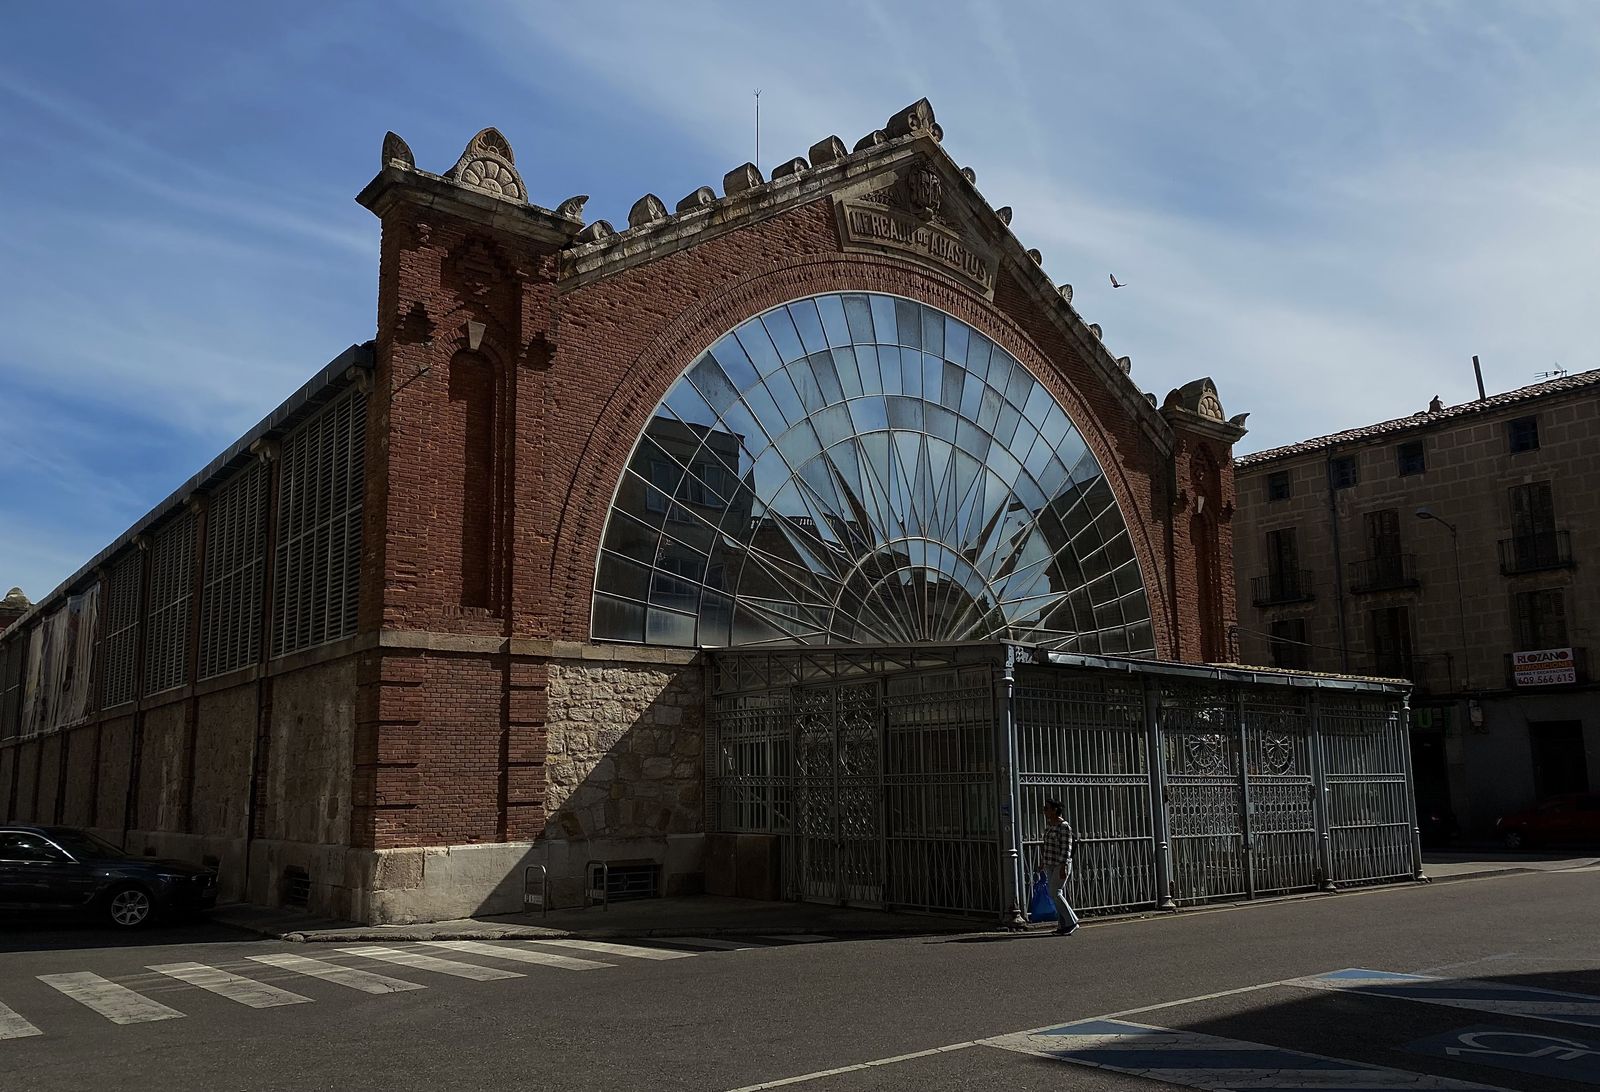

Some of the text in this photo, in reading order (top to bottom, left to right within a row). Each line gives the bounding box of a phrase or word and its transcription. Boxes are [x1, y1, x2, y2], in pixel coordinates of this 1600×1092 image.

[850, 211, 915, 246] MERCADO
[928, 231, 986, 282] ABASTOS
[1518, 673, 1574, 685] 609 566 615
